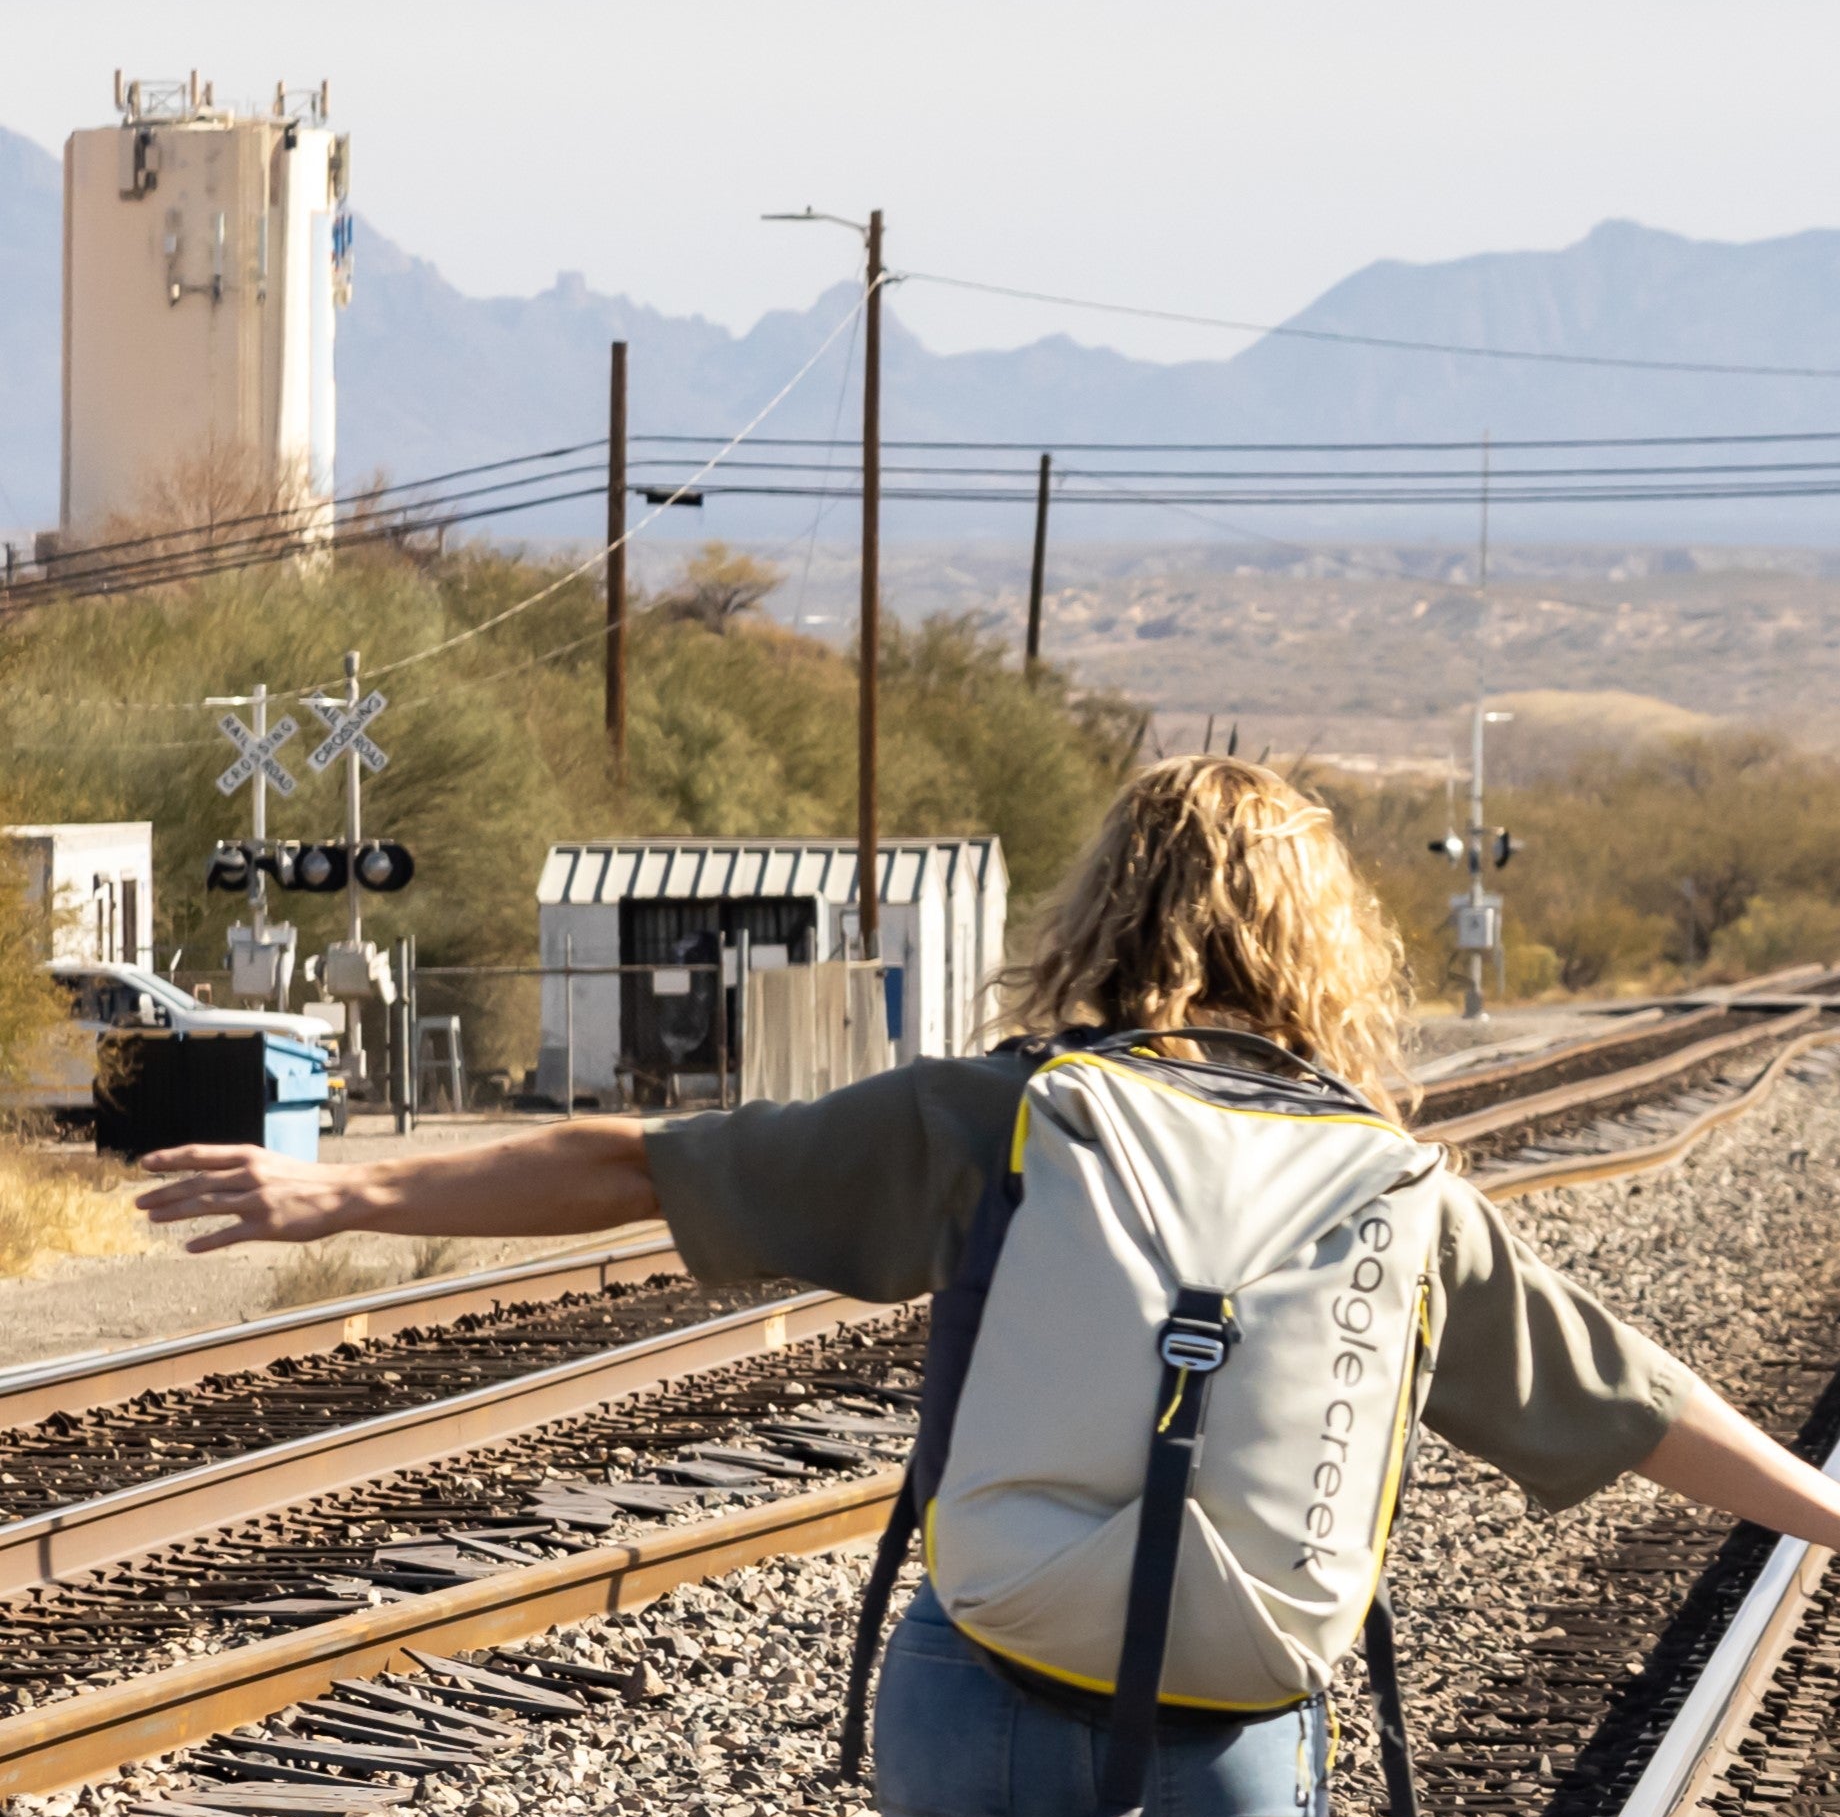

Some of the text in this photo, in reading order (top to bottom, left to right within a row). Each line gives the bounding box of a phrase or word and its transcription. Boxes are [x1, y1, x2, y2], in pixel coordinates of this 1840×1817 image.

[222, 719, 294, 788] CROSSING
[222, 717, 293, 791] RAIL ROAD
[314, 695, 382, 765] CROSSING
[352, 735, 385, 767] ROAD
[1290, 1215, 1394, 1571] eagle creek
